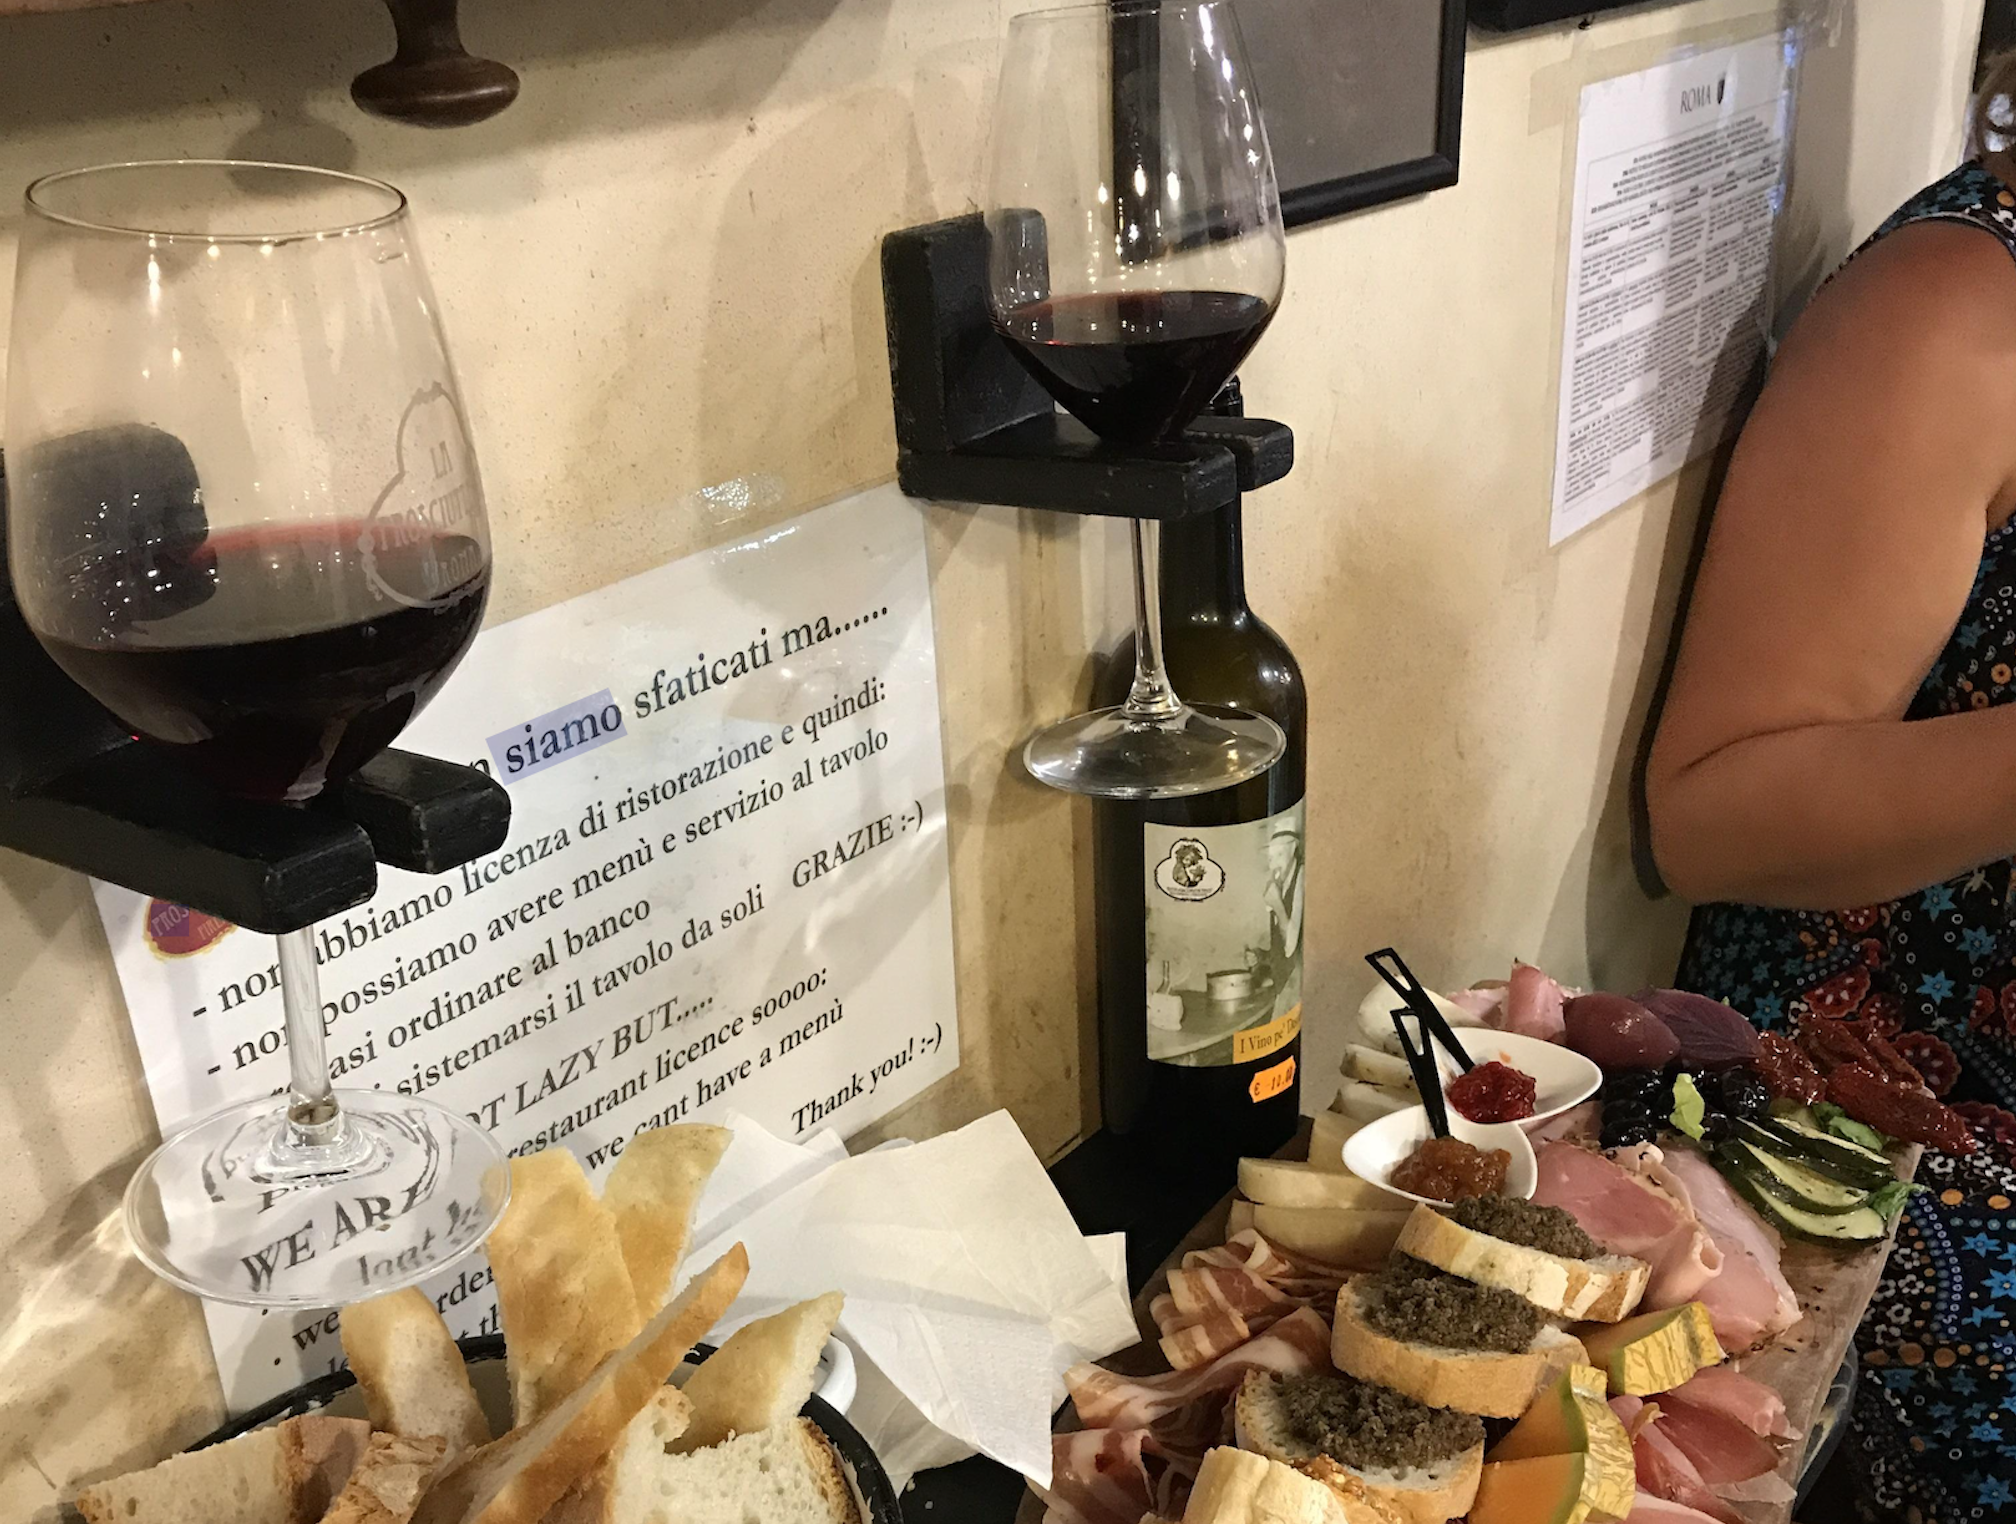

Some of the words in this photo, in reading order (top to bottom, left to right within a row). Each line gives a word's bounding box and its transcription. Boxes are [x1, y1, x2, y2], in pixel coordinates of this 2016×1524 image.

[1680, 84, 1711, 114] ROMA
[506, 703, 622, 774] siamo
[634, 627, 773, 719] sfaticati
[460, 828, 571, 897] licenza
[579, 800, 608, 838] di
[615, 734, 773, 823] ristorazione
[781, 725, 794, 745] e
[803, 677, 886, 744] quindi:
[232, 1024, 287, 1070] no
[322, 932, 477, 1038] possiamo
[487, 887, 564, 941] avere
[572, 838, 654, 899] menù
[662, 832, 677, 854] e
[686, 779, 784, 843] servizio
[792, 759, 813, 792] al
[820, 728, 888, 778] tavolo
[397, 994, 557, 1096] sistemarsi
[565, 980, 586, 1014] il
[592, 940, 673, 997] tavolo
[681, 918, 713, 949] da
[721, 884, 765, 929] soli
[792, 814, 894, 888] GRAZIE
[388, 966, 523, 1048] ordinare
[532, 937, 559, 975] al
[564, 900, 650, 957] banco
[1249, 1035, 1273, 1050] Vino
[507, 1069, 648, 1160] restaurant
[655, 1016, 744, 1083] licence
[752, 967, 828, 1026] soooo:
[514, 1038, 604, 1116] LAZY
[586, 1136, 625, 1171] we
[634, 1094, 689, 1137] cant
[696, 1059, 751, 1108] have
[760, 1046, 772, 1069] a
[779, 998, 844, 1057] menù
[791, 1072, 864, 1136] Thank
[869, 1037, 914, 1094] you!
[1253, 1082, 1261, 1096] €
